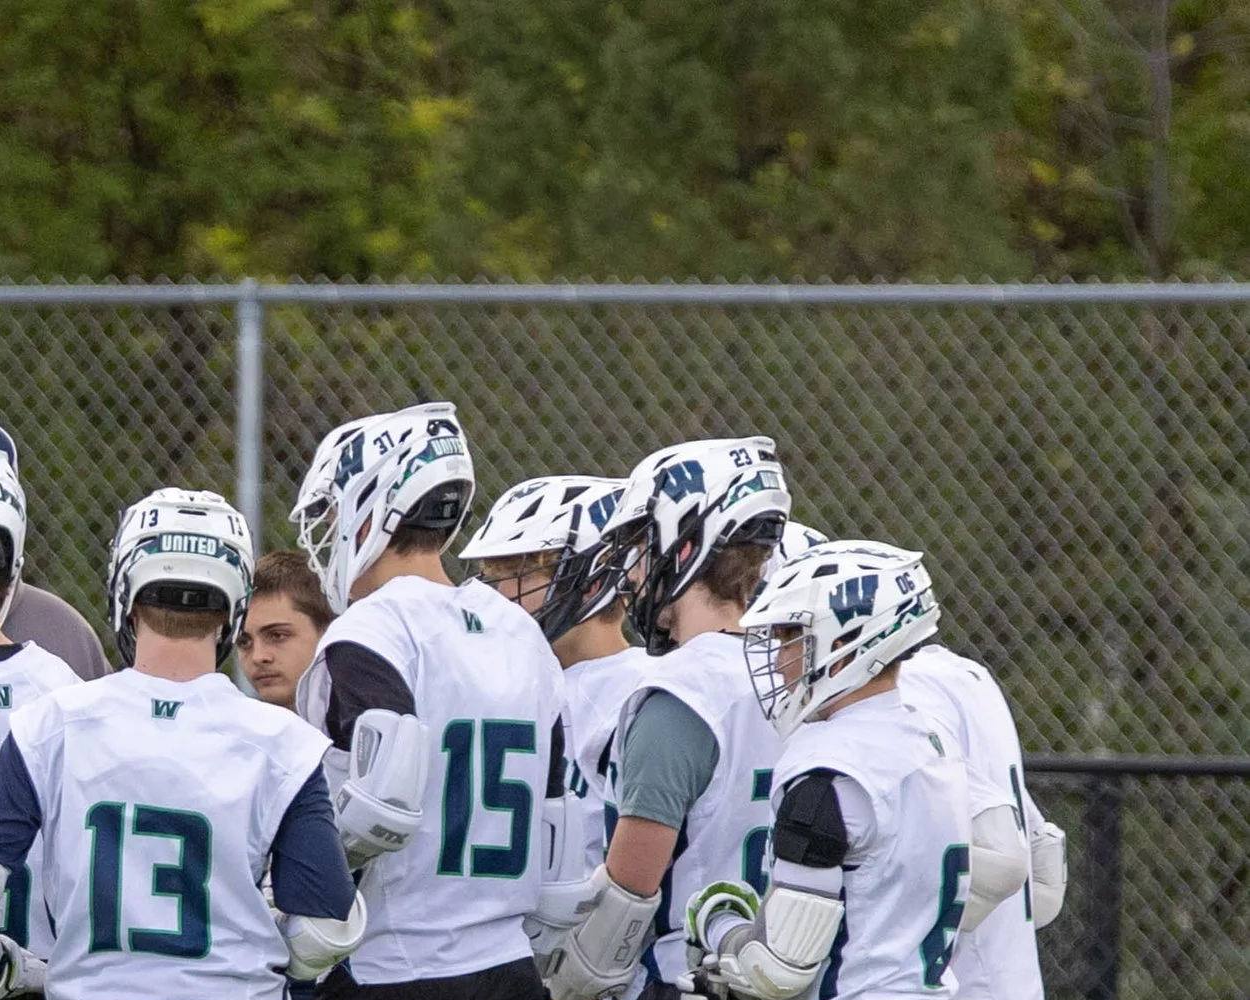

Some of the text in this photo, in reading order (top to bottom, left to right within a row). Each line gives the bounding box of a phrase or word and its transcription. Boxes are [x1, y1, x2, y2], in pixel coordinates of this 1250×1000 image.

[373, 430, 395, 455] 37
[729, 448, 753, 468] 23
[653, 459, 707, 505] W
[140, 508, 159, 528] 13
[161, 534, 218, 556] UNITED
[894, 571, 916, 595] 06
[828, 574, 879, 629] W
[461, 608, 484, 634] W
[151, 698, 184, 721] W
[436, 717, 537, 880] 15
[84, 800, 214, 958] 13
[615, 919, 643, 962] EVO
